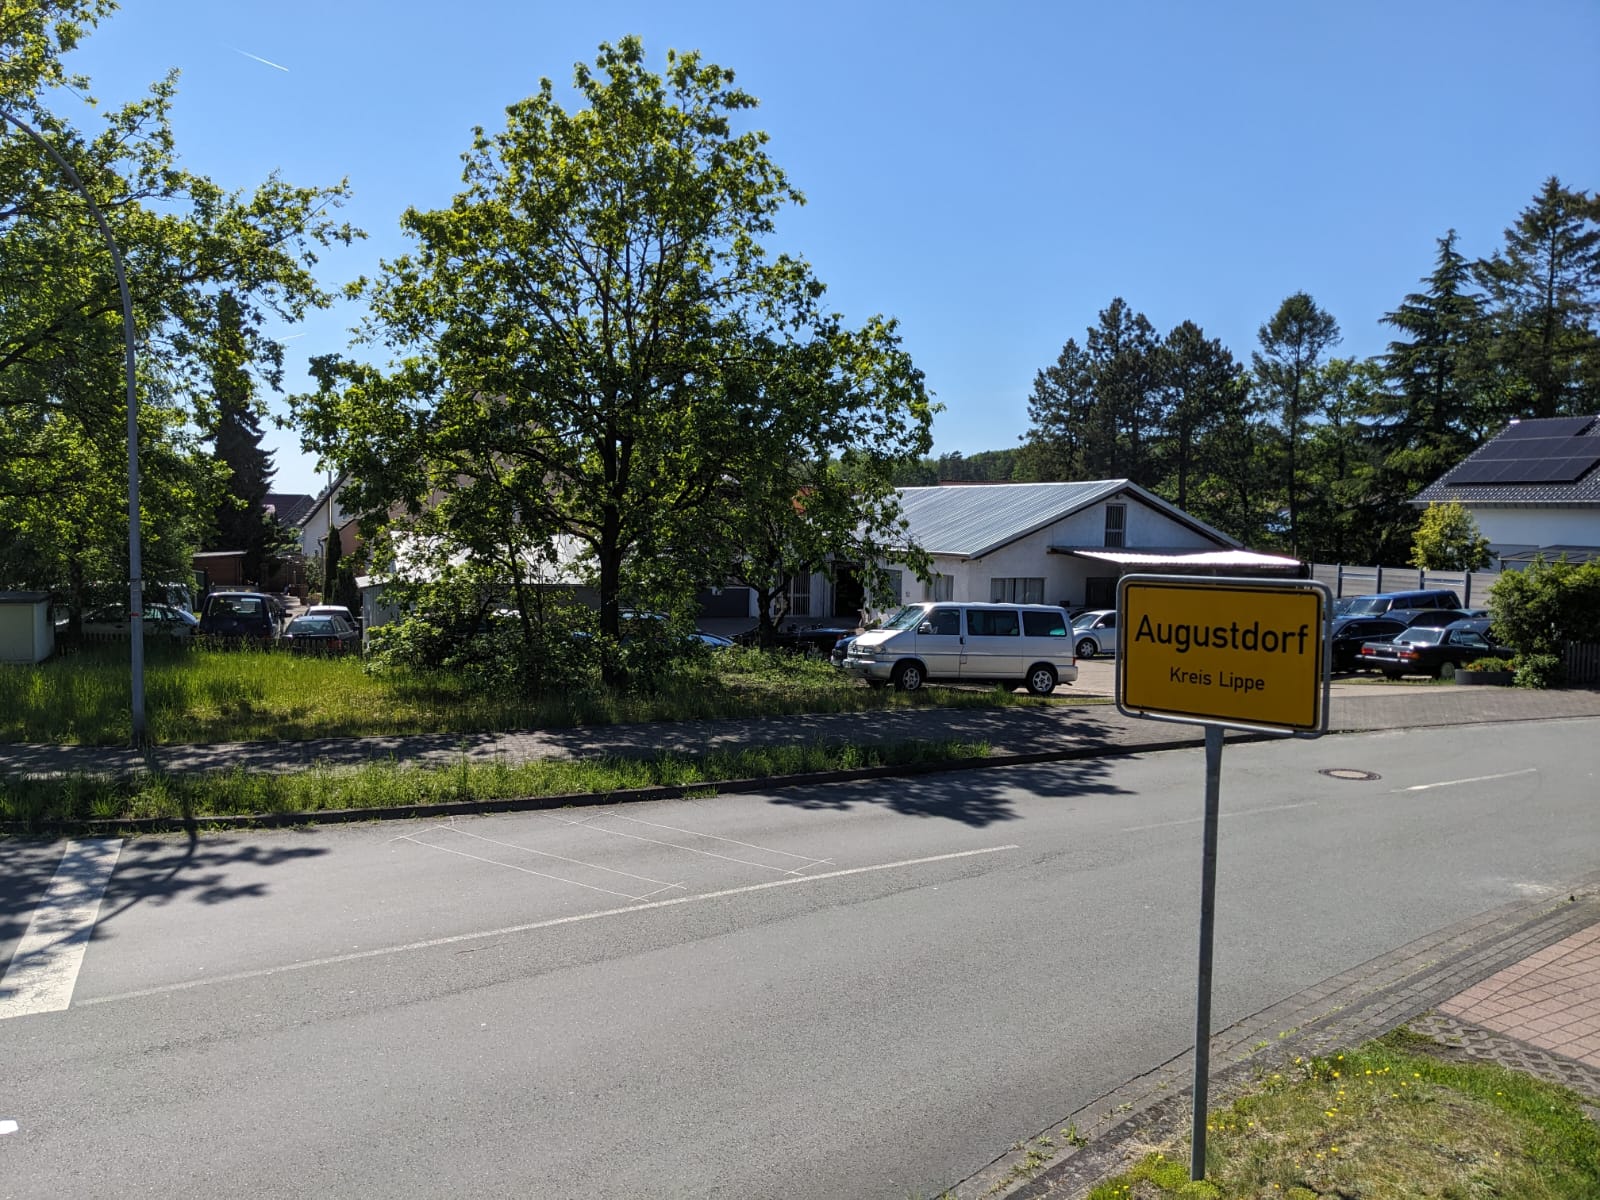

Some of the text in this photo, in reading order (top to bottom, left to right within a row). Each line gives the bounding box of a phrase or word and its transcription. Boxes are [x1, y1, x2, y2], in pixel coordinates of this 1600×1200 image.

[1135, 614, 1309, 655] Augustdorf
[1170, 667, 1265, 693] Kreis Lippe
